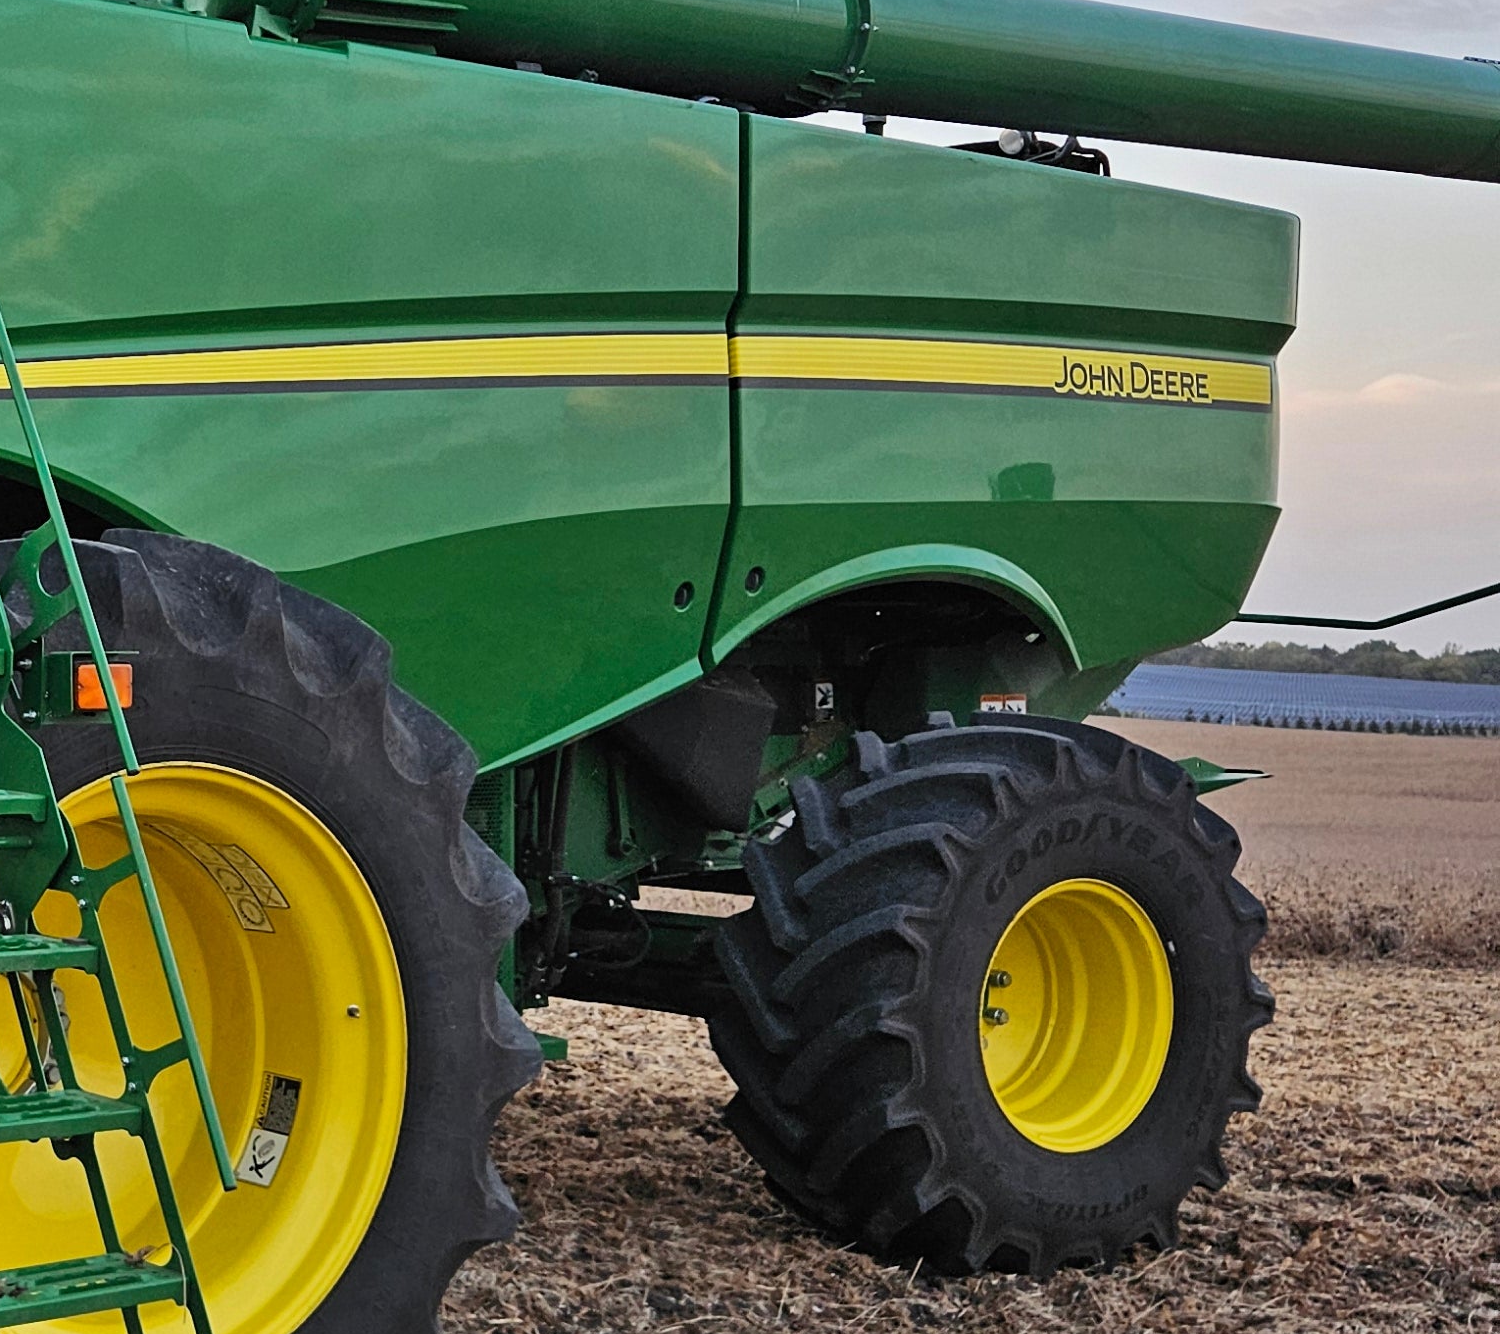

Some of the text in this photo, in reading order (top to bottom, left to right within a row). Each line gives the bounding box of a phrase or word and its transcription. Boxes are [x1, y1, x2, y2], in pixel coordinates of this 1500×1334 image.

[1054, 355, 1210, 399] JOHN DEERE
[984, 812, 1206, 906] GOODYEAR
[259, 1074, 272, 1116] CAUTION
